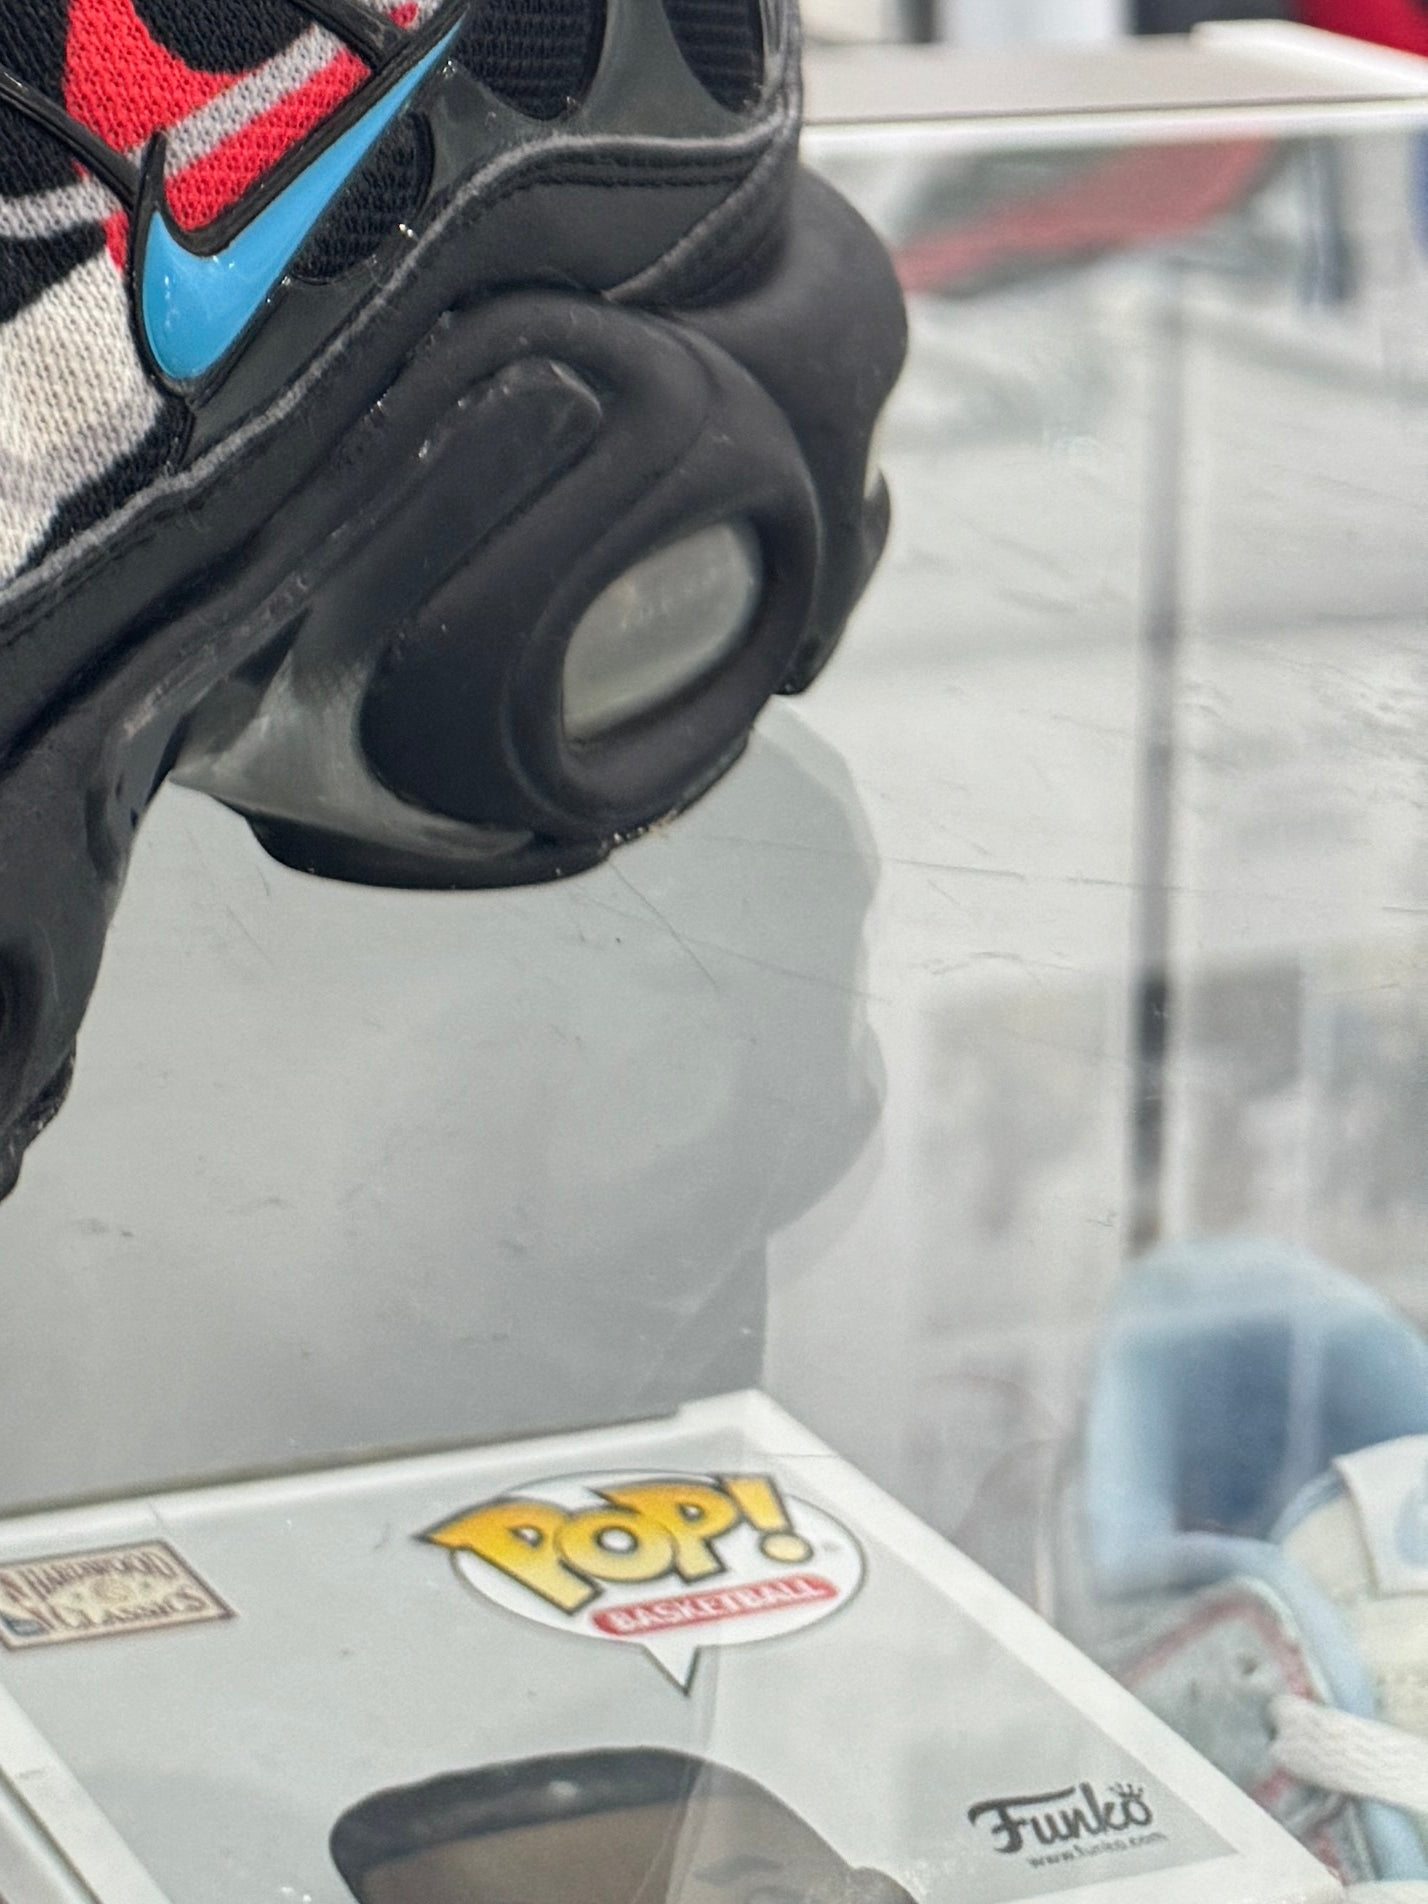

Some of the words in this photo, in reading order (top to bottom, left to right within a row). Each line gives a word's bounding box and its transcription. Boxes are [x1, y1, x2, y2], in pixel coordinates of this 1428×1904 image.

[412, 1472, 814, 1615] POP!
[609, 1579, 825, 1633] BASKETBALL
[968, 1782, 1153, 1853] Funko
